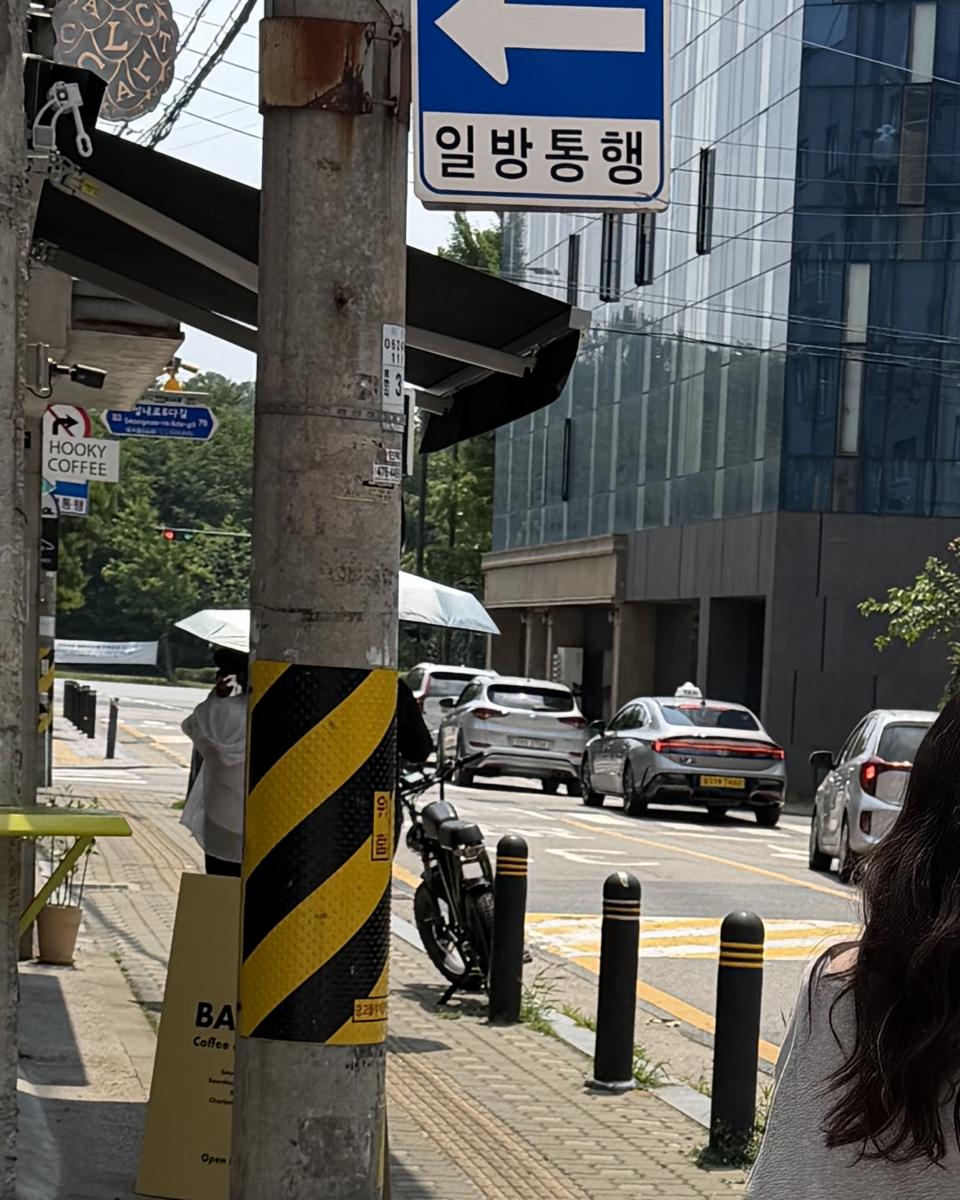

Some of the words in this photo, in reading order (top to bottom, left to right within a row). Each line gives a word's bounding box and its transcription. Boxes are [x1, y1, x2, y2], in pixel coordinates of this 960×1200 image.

[435, 124, 643, 185] 일방통행
[49, 440, 107, 459] HOOKY
[47, 457, 107, 477] COFFEE
[193, 1036, 230, 1051] Coffee
[201, 1153, 227, 1166] Open
